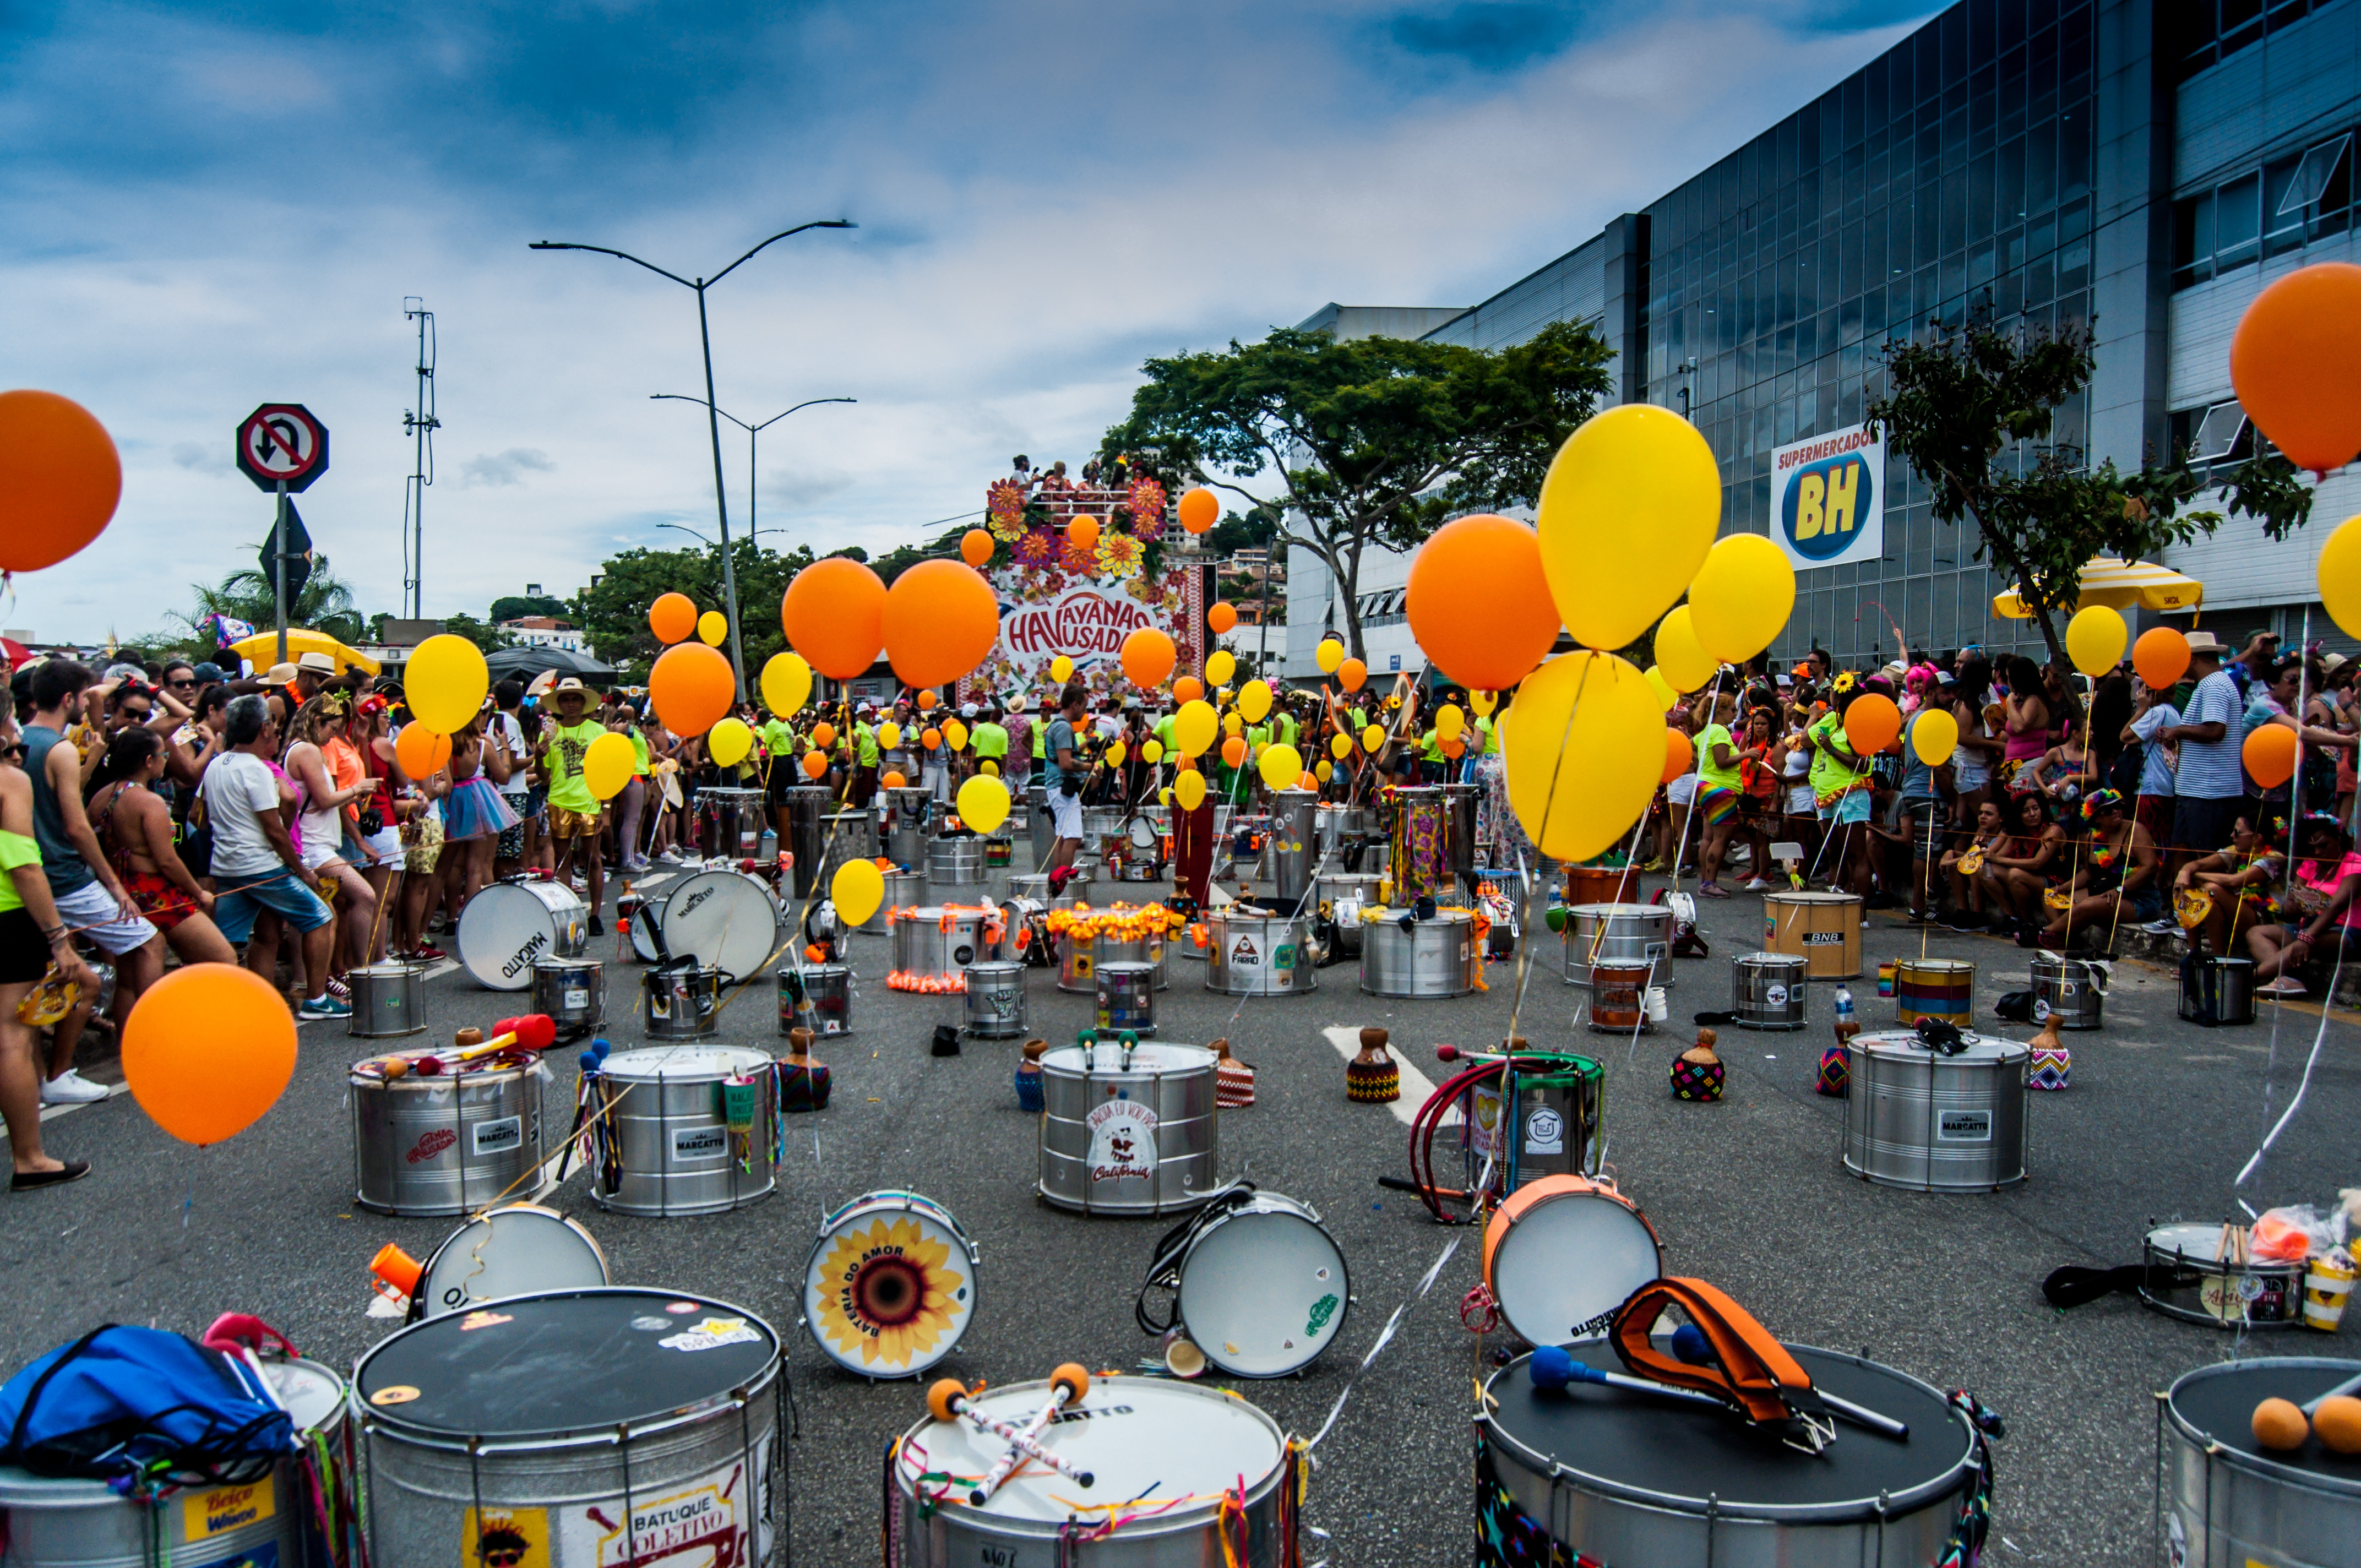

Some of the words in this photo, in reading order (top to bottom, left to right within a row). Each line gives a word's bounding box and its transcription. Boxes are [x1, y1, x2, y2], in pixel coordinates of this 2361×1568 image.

[1794, 460, 1859, 541] BH
[2019, 606, 2034, 614] SKO
[1062, 625, 1131, 654] USAD
[1811, 933, 1838, 941] BNB
[502, 932, 548, 979] MARCATTO
[1943, 1122, 1988, 1131] MARCATTO
[677, 1138, 724, 1150] MARCATTO
[862, 1245, 904, 1263] AMOR
[844, 1262, 859, 1282] DO
[841, 1287, 880, 1338] BATERIA
[634, 1496, 711, 1532] BATUQUE
[617, 1510, 723, 1559] COLETIVO
